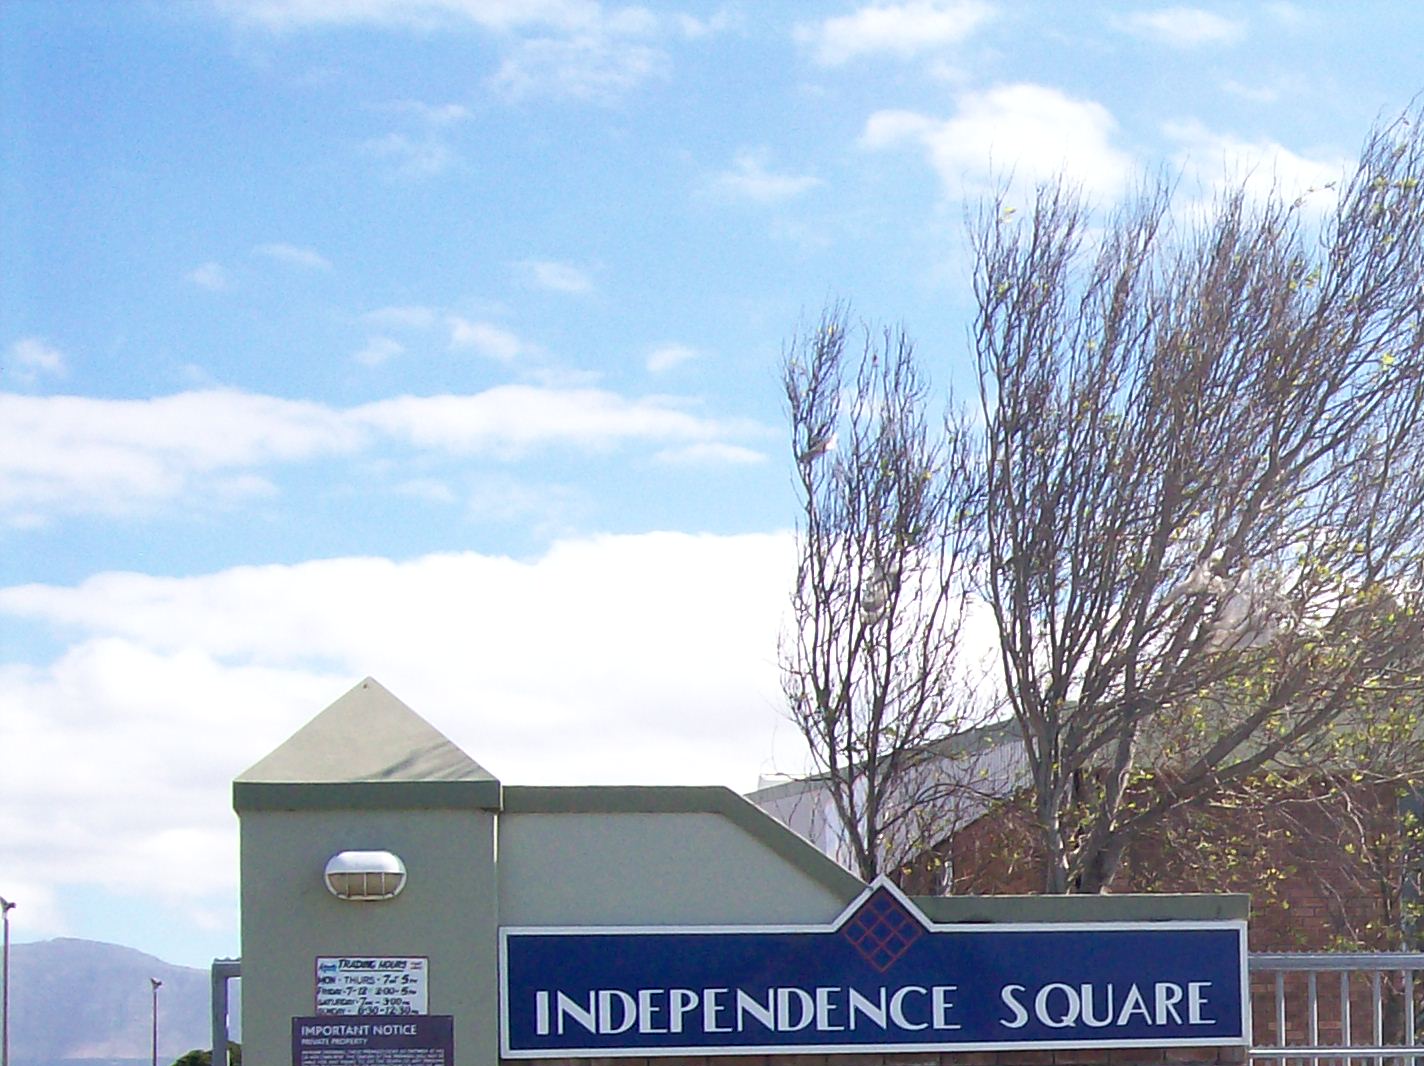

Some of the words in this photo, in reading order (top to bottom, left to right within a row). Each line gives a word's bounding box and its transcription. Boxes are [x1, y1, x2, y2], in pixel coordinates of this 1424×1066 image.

[535, 985, 962, 1036] INDEPENDENCE
[999, 980, 1217, 1029] SQUARE
[301, 1025, 370, 1036] IMPORTANT
[372, 1024, 417, 1035] NOTICE
